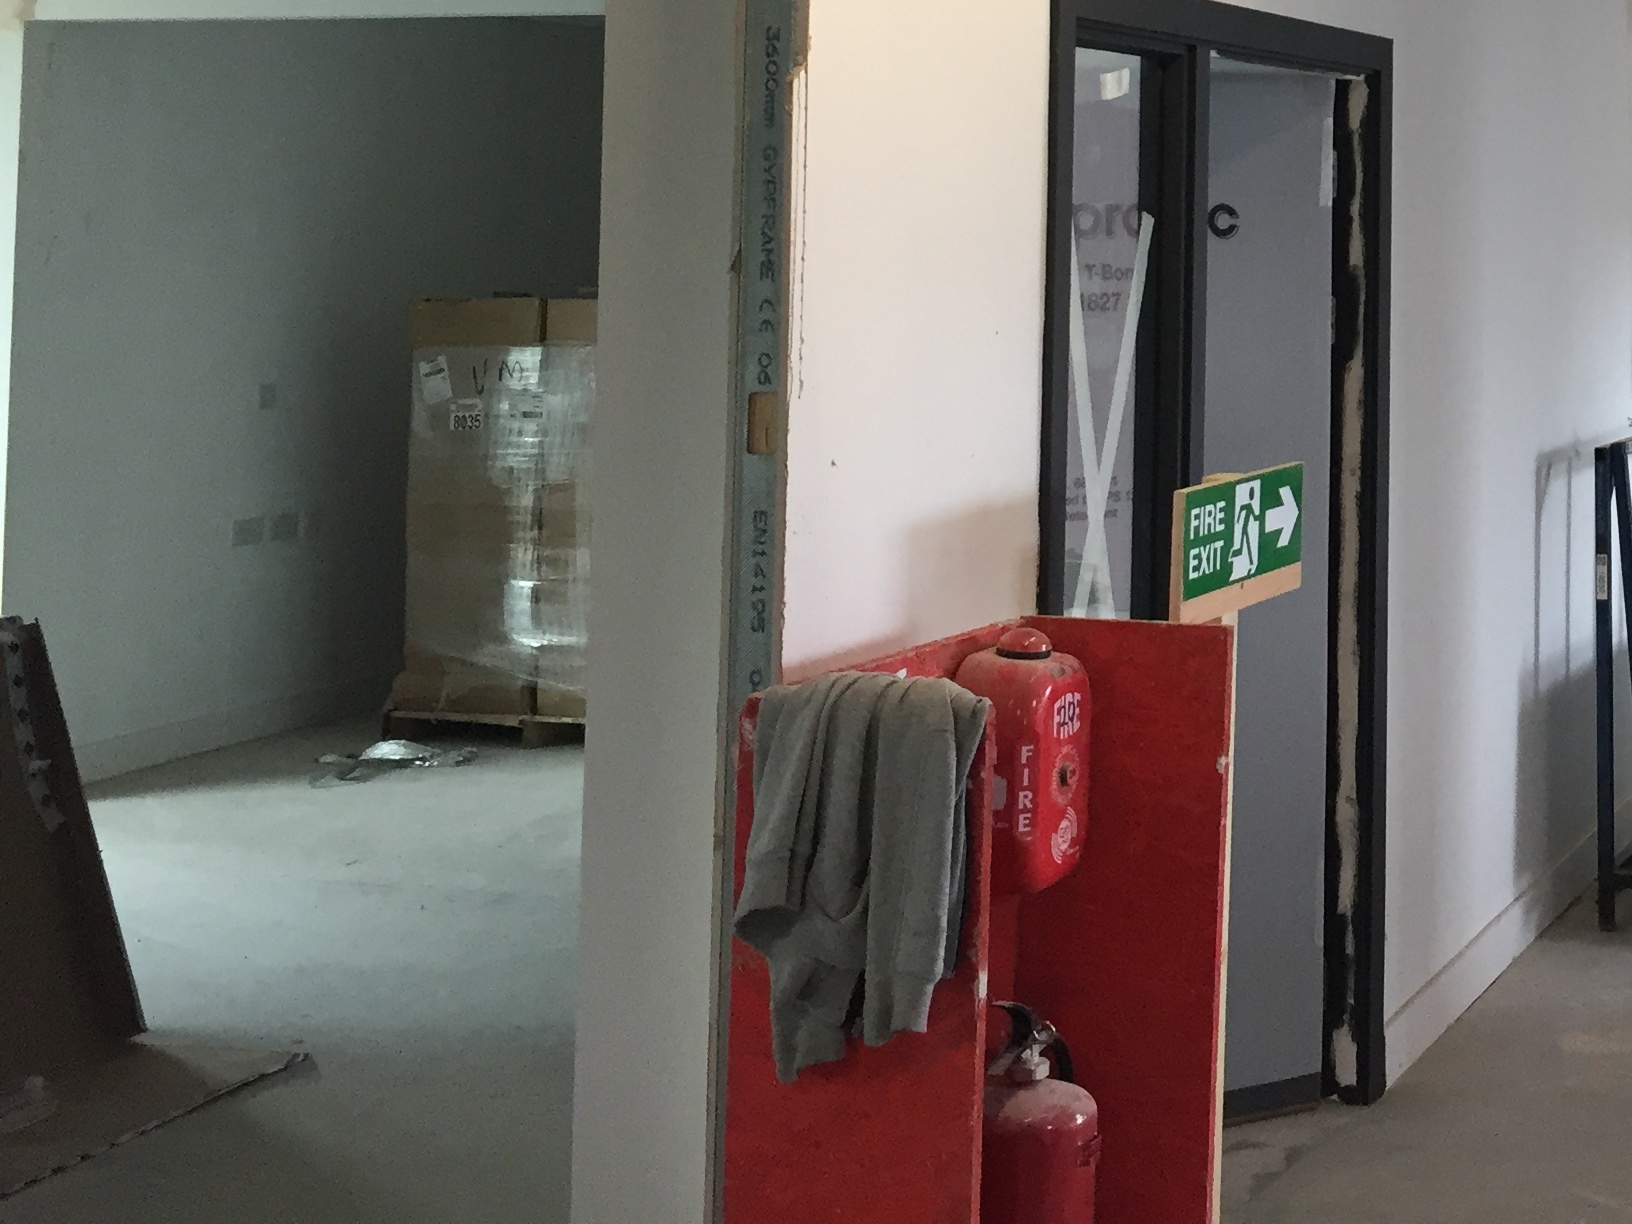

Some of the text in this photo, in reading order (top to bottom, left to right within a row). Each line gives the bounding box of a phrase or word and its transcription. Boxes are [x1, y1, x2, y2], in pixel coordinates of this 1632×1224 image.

[759, 144, 778, 282] GYPFRAME
[756, 352, 773, 386] 06
[453, 413, 482, 431] 8035
[1189, 501, 1227, 541] FIRE
[750, 510, 769, 634] EN14195
[1188, 540, 1225, 581] EXIT
[1053, 692, 1081, 740] FIRE
[1018, 745, 1035, 832] FIRE
